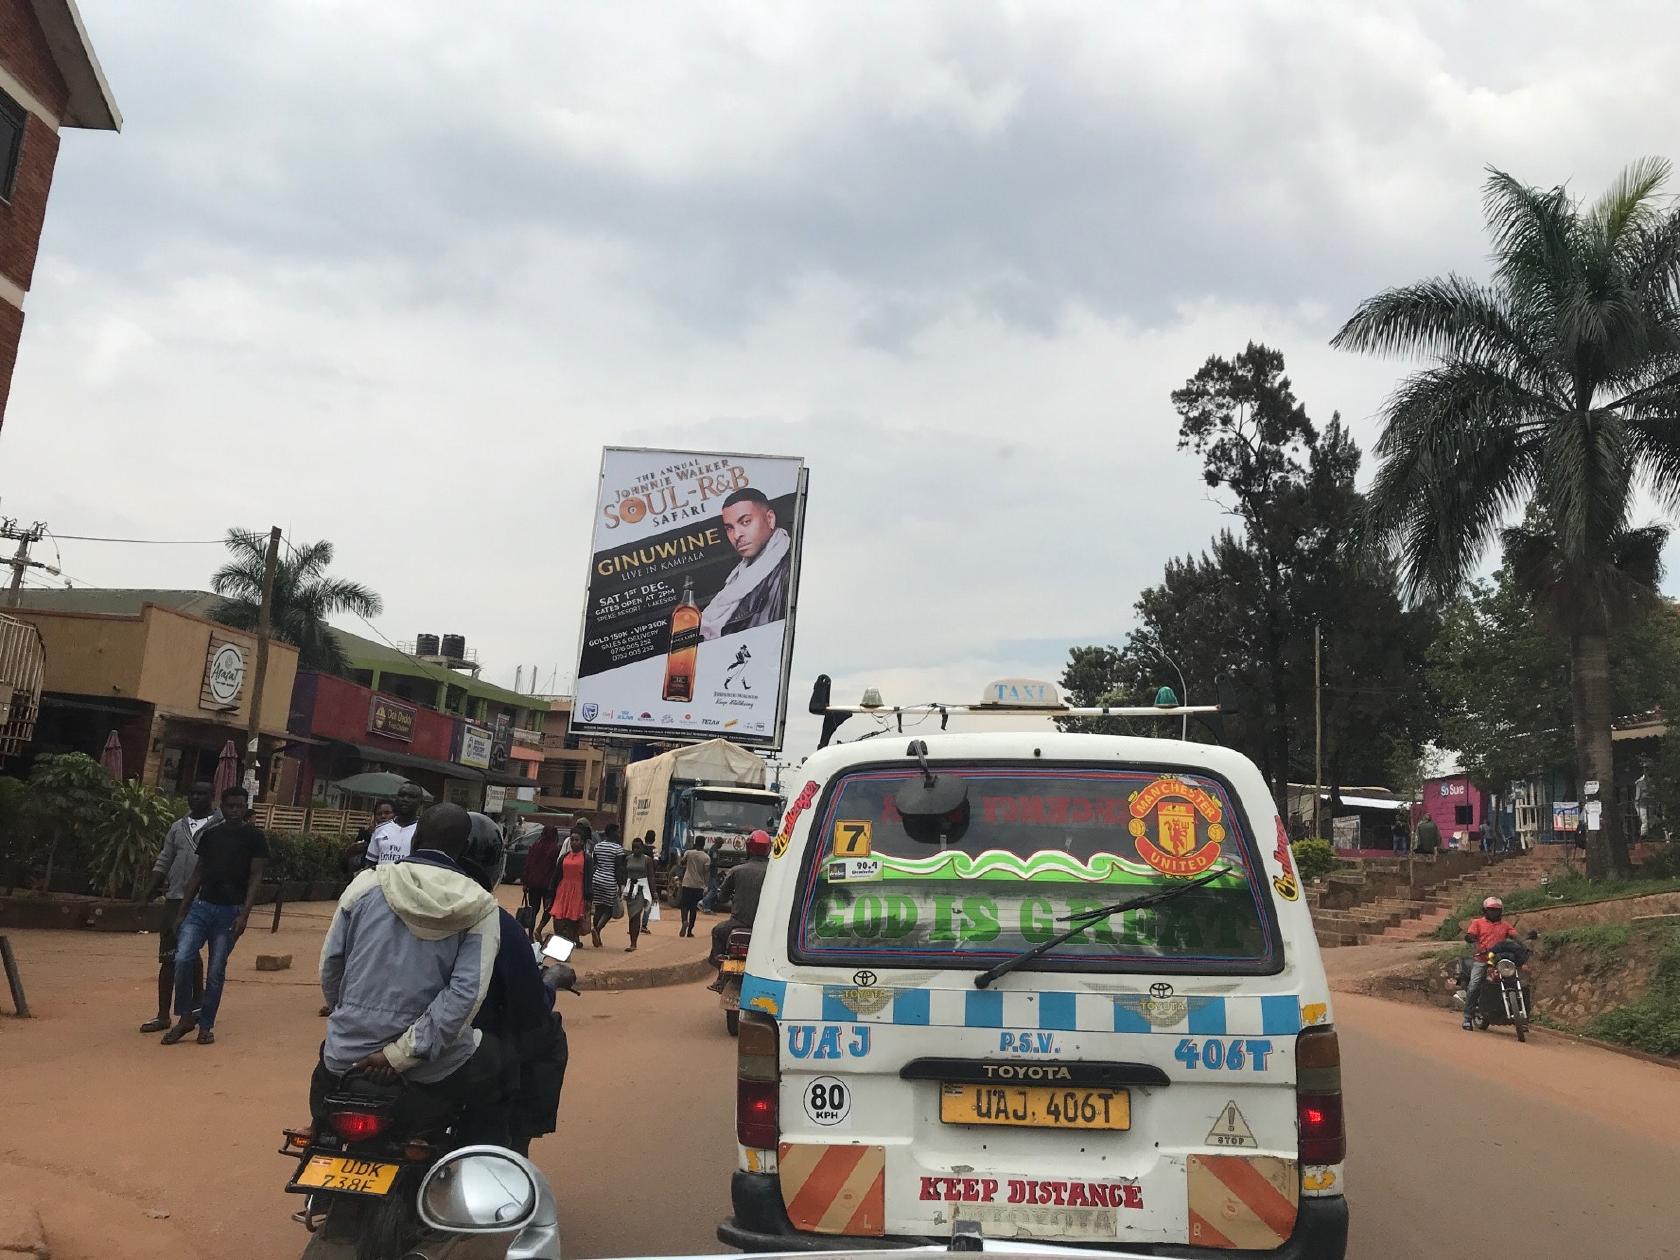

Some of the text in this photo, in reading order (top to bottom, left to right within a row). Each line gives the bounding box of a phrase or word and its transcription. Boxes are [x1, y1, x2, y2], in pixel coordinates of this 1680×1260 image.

[615, 459, 731, 503] JOHNNIE WALKER
[635, 458, 700, 484] THE ANNUAL
[652, 503, 707, 528] SAFARI
[597, 527, 721, 576] GINUWINE
[621, 551, 705, 581] LIVE IN KAMPALA
[595, 603, 620, 616] GATES
[621, 597, 643, 608] OPEN
[645, 594, 656, 602] AT
[599, 593, 621, 607] SAT
[588, 635, 609, 647] GOLD
[994, 684, 1045, 700] TAXI
[843, 825, 864, 852] 7
[1136, 782, 1216, 871] MANCHESTER UNITED
[814, 894, 920, 941] GOD
[929, 895, 1001, 943] IS
[844, 989, 886, 999] TOYOTA
[1140, 1002, 1185, 1011] TOYOTA
[788, 1025, 871, 1060] UAJ
[1174, 1038, 1273, 1072] 406T
[983, 1065, 1072, 1080] TOYOTA
[811, 1083, 845, 1111] 80
[1047, 1091, 1114, 1123] 406T
[816, 1111, 838, 1119] KPH
[1217, 1136, 1245, 1145] STOP
[341, 1159, 384, 1178] UDK
[919, 1176, 1144, 1209] KEEP DISTANCE
